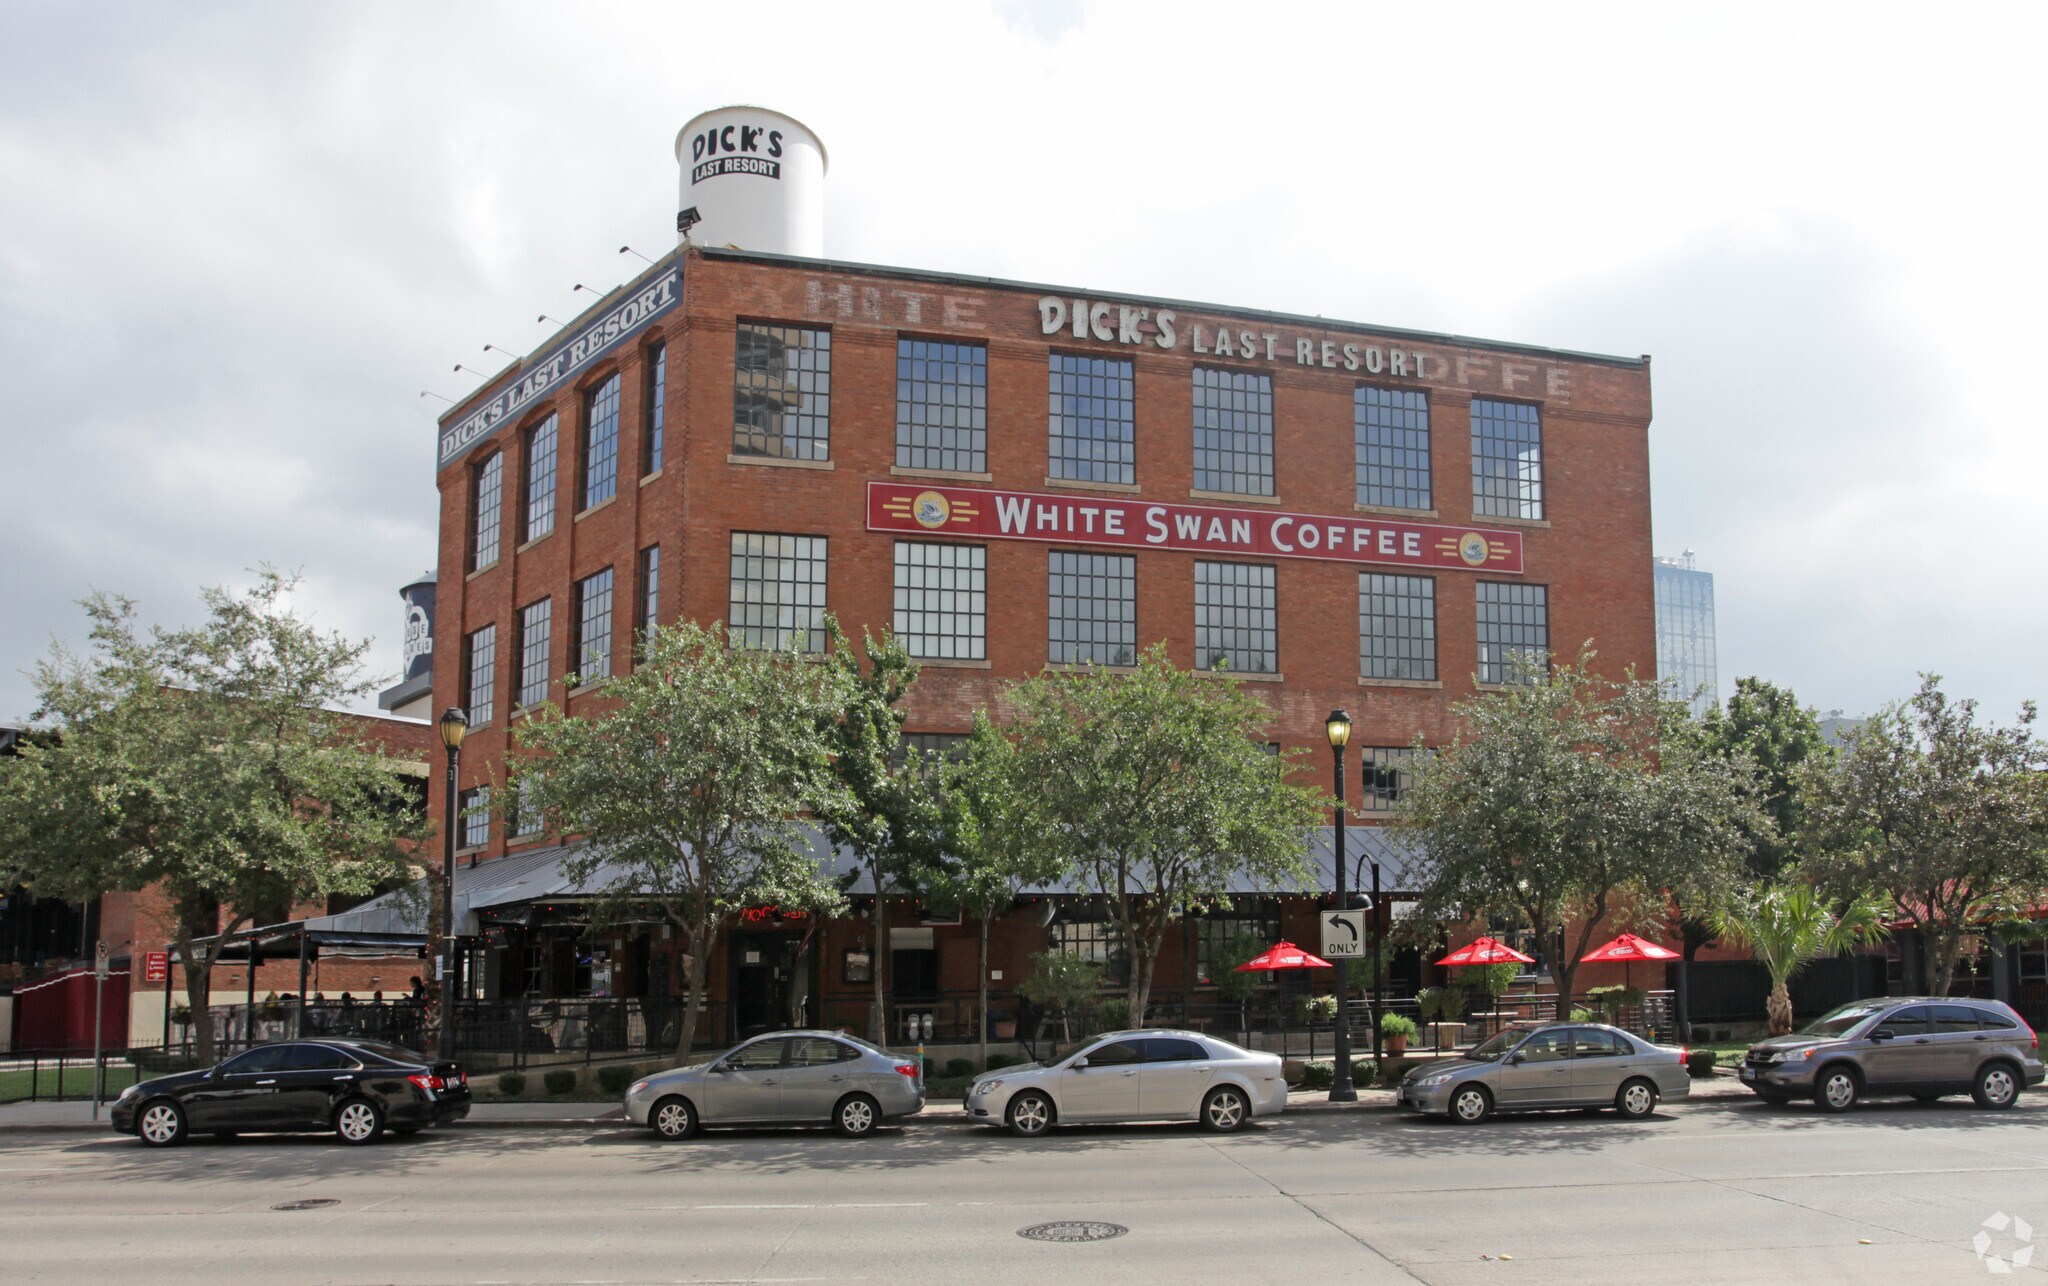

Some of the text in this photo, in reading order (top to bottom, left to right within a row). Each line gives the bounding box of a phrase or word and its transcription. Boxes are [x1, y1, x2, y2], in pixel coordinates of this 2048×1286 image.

[692, 125, 783, 162] DICK'S
[695, 157, 776, 181] LAST RESORT
[1038, 295, 1429, 380] DICK'S LAST RESORT
[440, 273, 678, 458] DICK'S LAST RESORT
[994, 495, 1422, 559] WHITE SWAN COFFEE
[1329, 943, 1358, 954] ONLY
